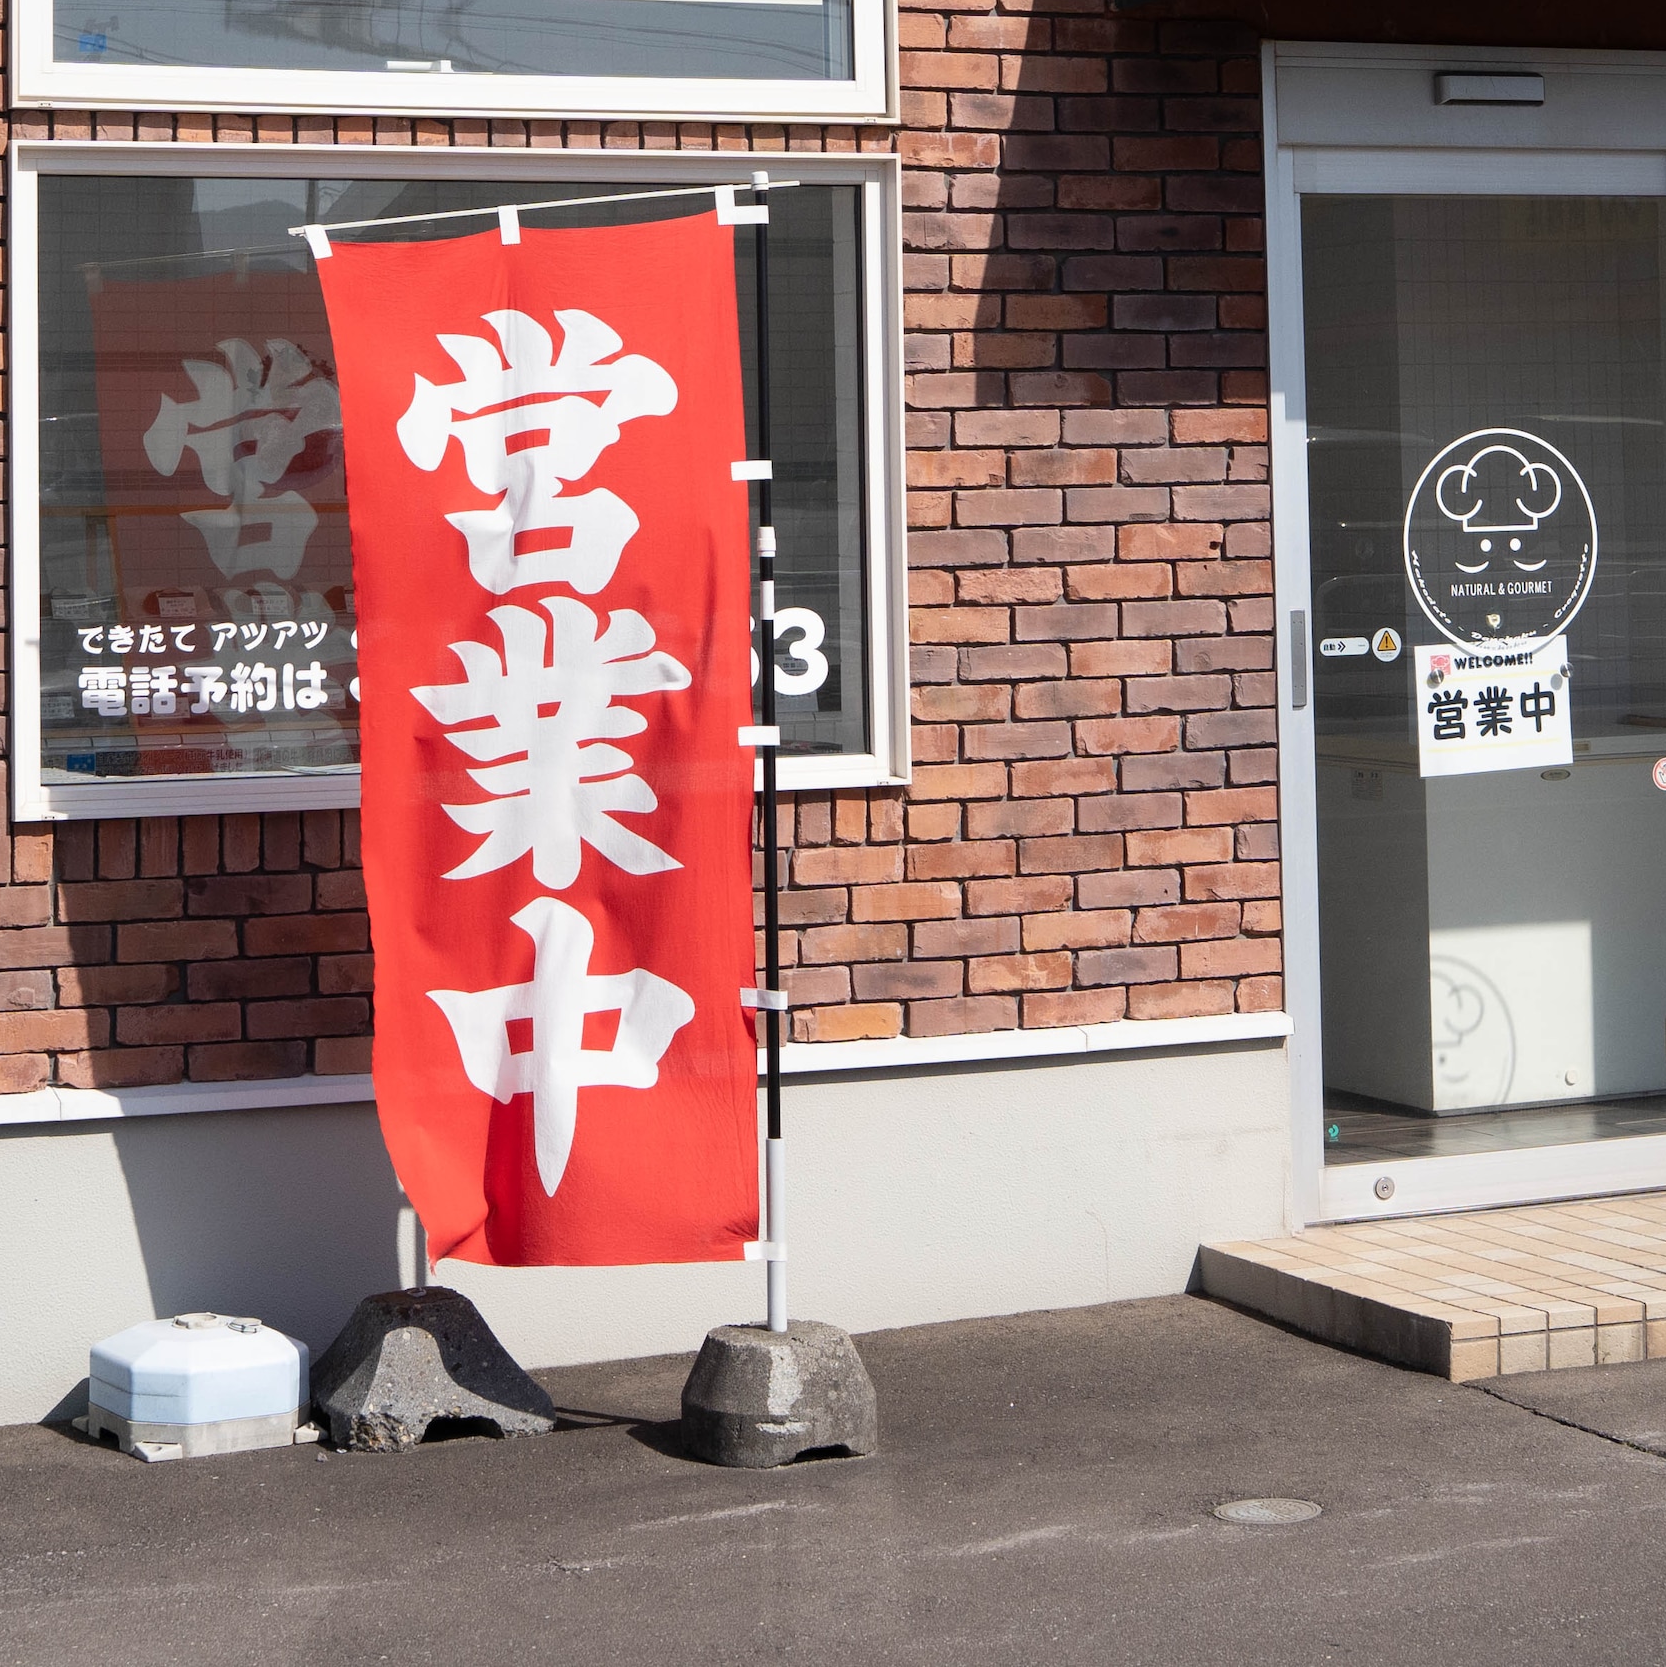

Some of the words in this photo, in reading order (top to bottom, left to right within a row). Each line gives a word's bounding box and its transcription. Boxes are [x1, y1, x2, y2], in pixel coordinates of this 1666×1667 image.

[1451, 583, 1496, 597] NATURAL
[1498, 582, 1506, 595] &
[1507, 580, 1553, 595] GOURMET
[77, 623, 196, 654] できたて
[211, 620, 329, 652] アツアツ
[1454, 651, 1534, 670] WELCOME!!
[77, 660, 329, 717] 電話予約は
[1427, 681, 1556, 740] 営業中
[396, 307, 697, 1199] 営業中
